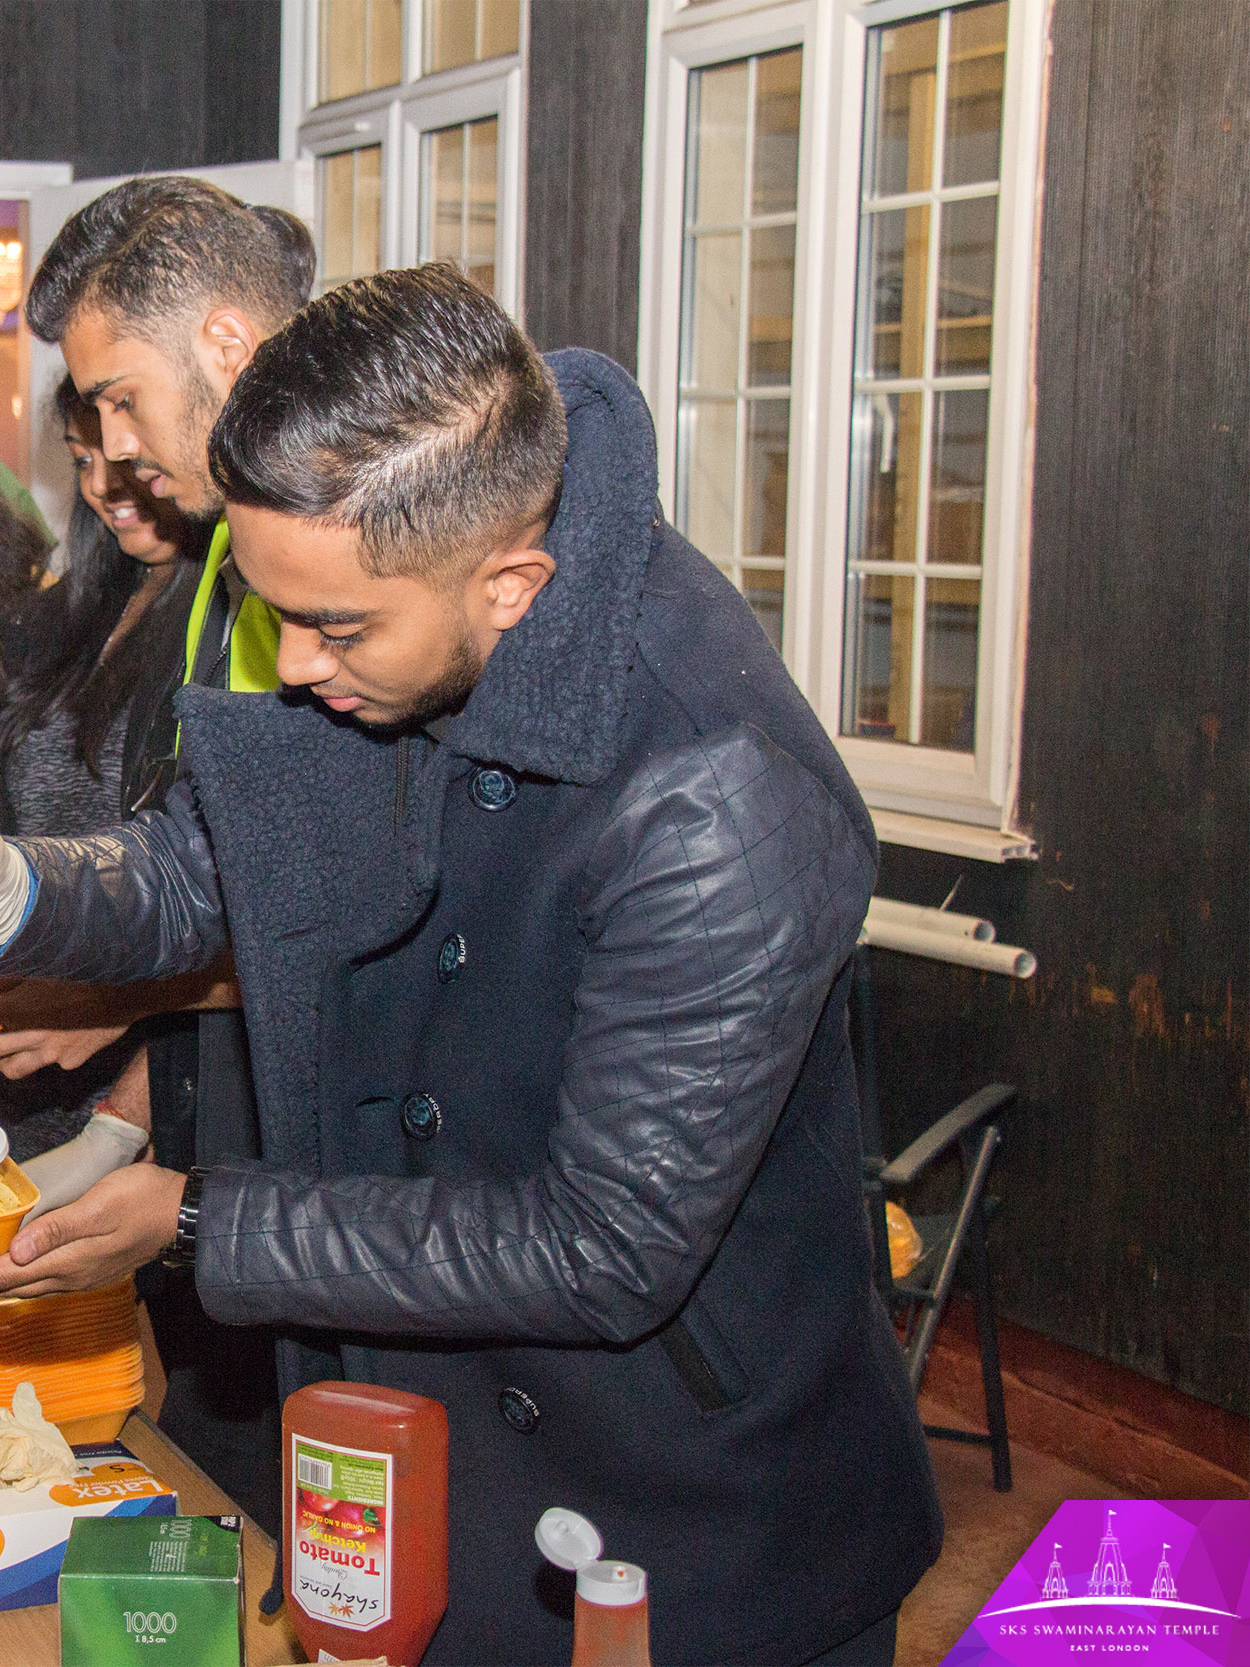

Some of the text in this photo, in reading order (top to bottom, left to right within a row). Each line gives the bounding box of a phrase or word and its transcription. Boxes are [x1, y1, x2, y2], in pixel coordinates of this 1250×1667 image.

[72, 1479, 163, 1499] Latex
[302, 1510, 323, 1523] GARLIC
[323, 1517, 334, 1526] NO
[341, 1521, 363, 1532] ONION
[364, 1526, 376, 1534] NO
[309, 1527, 367, 1554] Ketchup
[299, 1540, 380, 1577] Tomato
[320, 1561, 348, 1580] Quality
[299, 1579, 379, 1613] shayona
[123, 1611, 177, 1634] 1000
